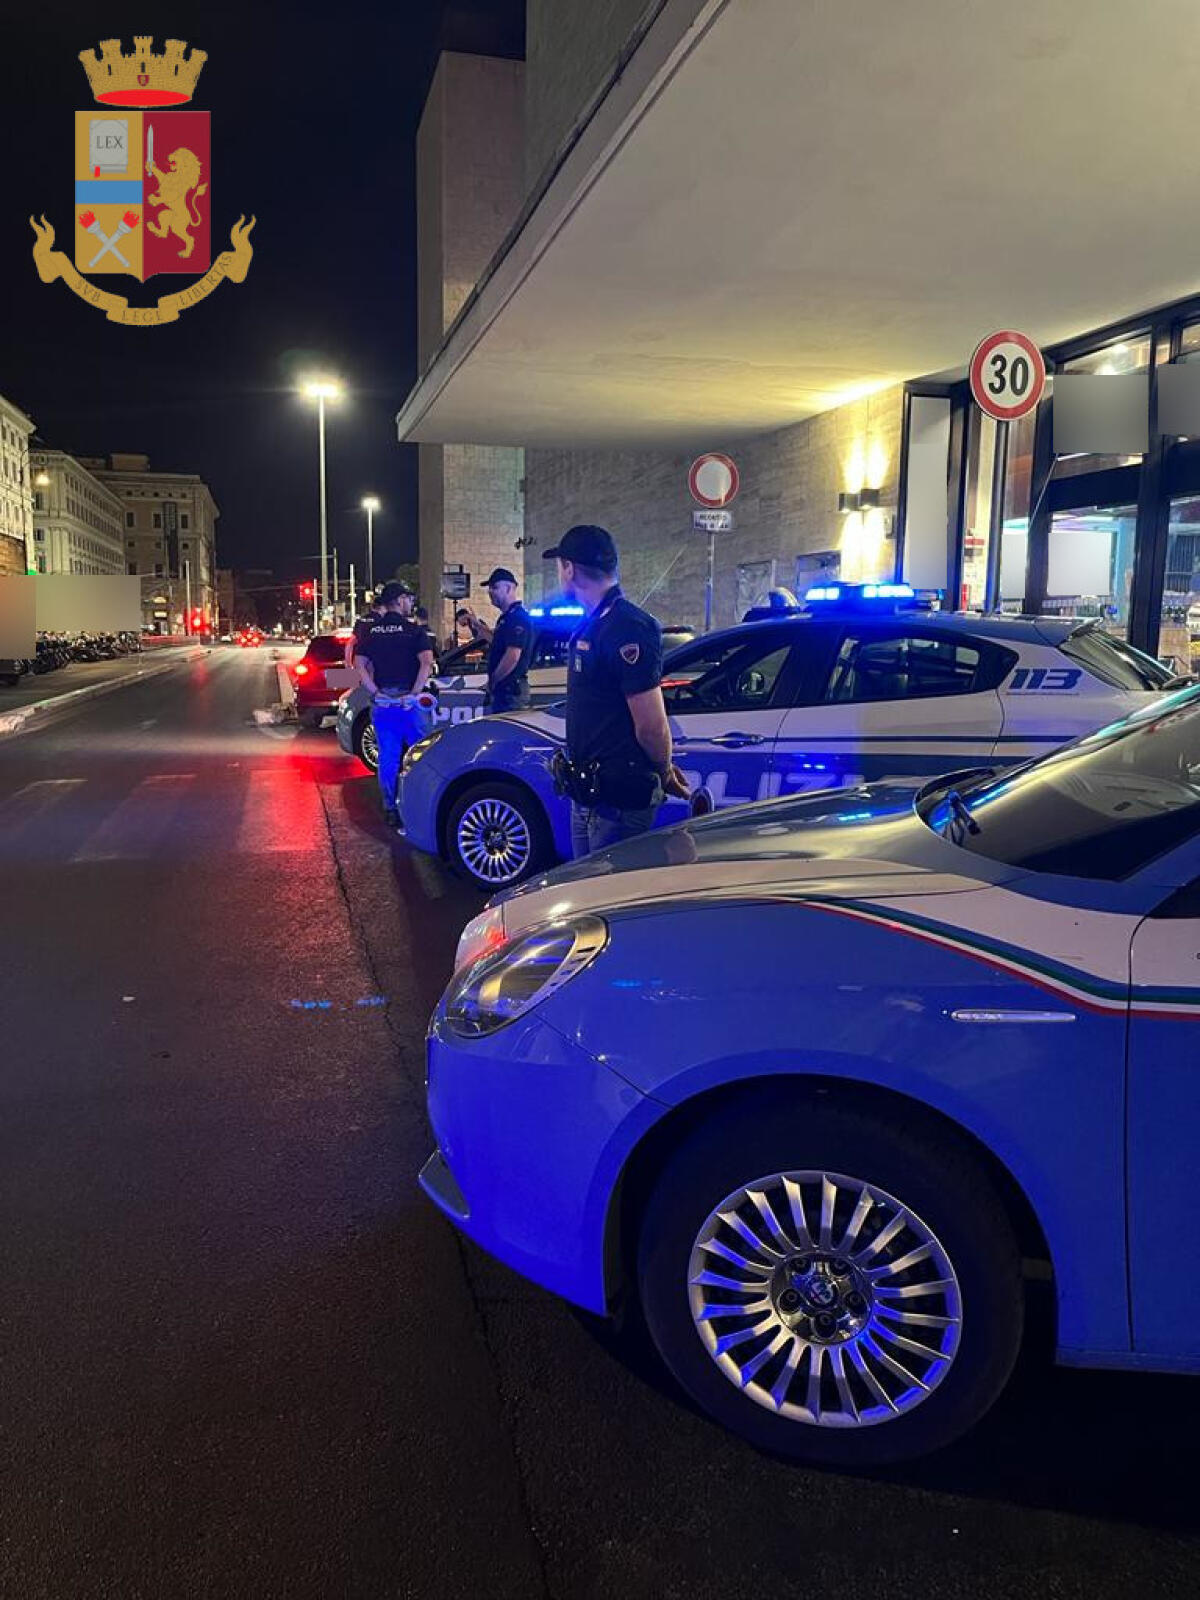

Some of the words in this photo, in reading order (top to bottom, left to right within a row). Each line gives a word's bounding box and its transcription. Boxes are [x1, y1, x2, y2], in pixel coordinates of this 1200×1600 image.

[988, 354, 1029, 396] 30
[370, 625, 403, 634] POLIZIA
[1009, 668, 1083, 689] 113
